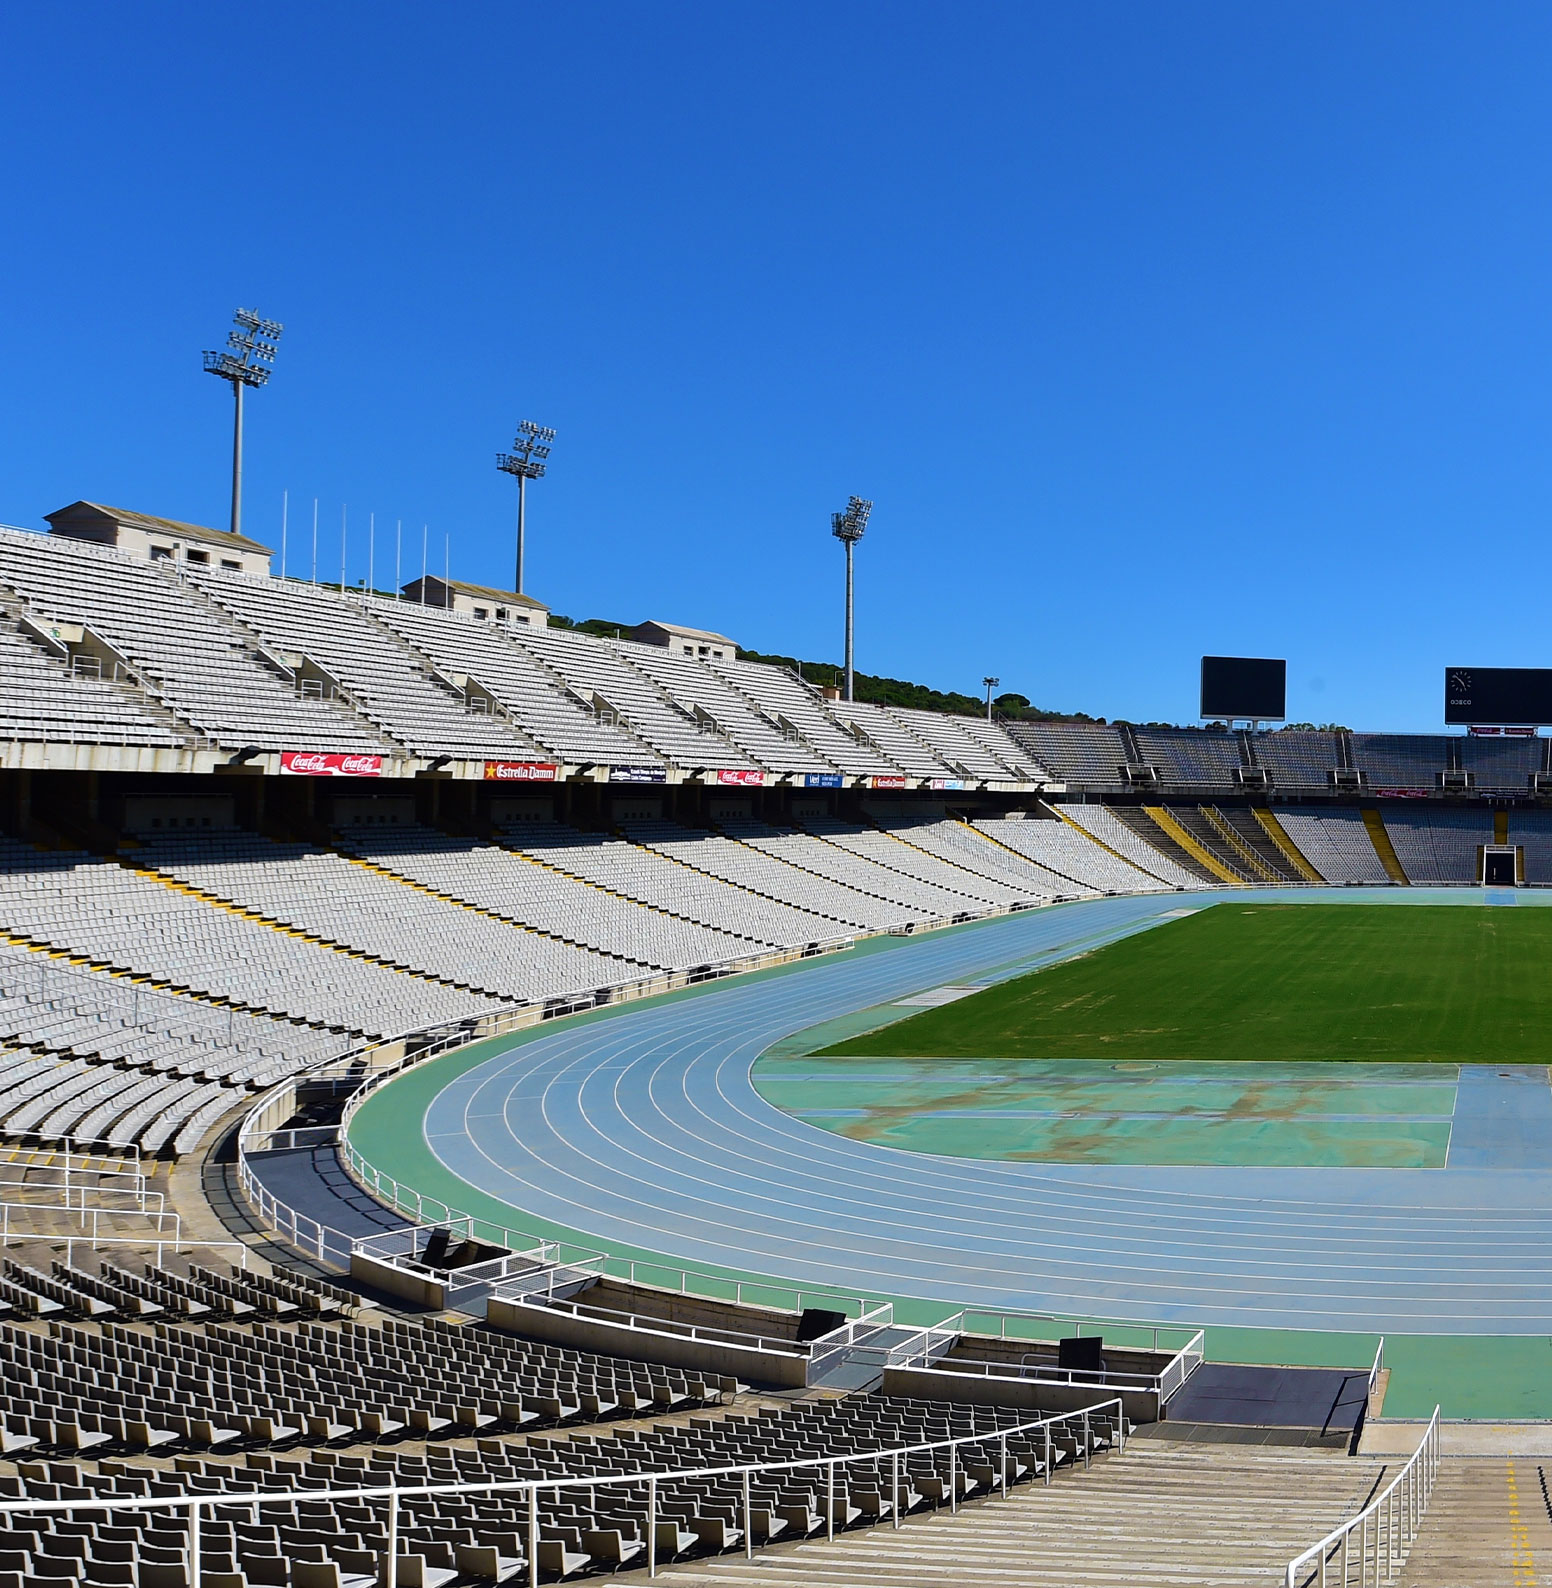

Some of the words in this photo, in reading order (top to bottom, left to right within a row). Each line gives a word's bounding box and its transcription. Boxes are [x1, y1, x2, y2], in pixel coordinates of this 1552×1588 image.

[290, 754, 329, 770] Coca-Cola
[341, 756, 376, 771] Coca-Cola
[496, 764, 528, 778] Estrella
[528, 766, 554, 779] Damm
